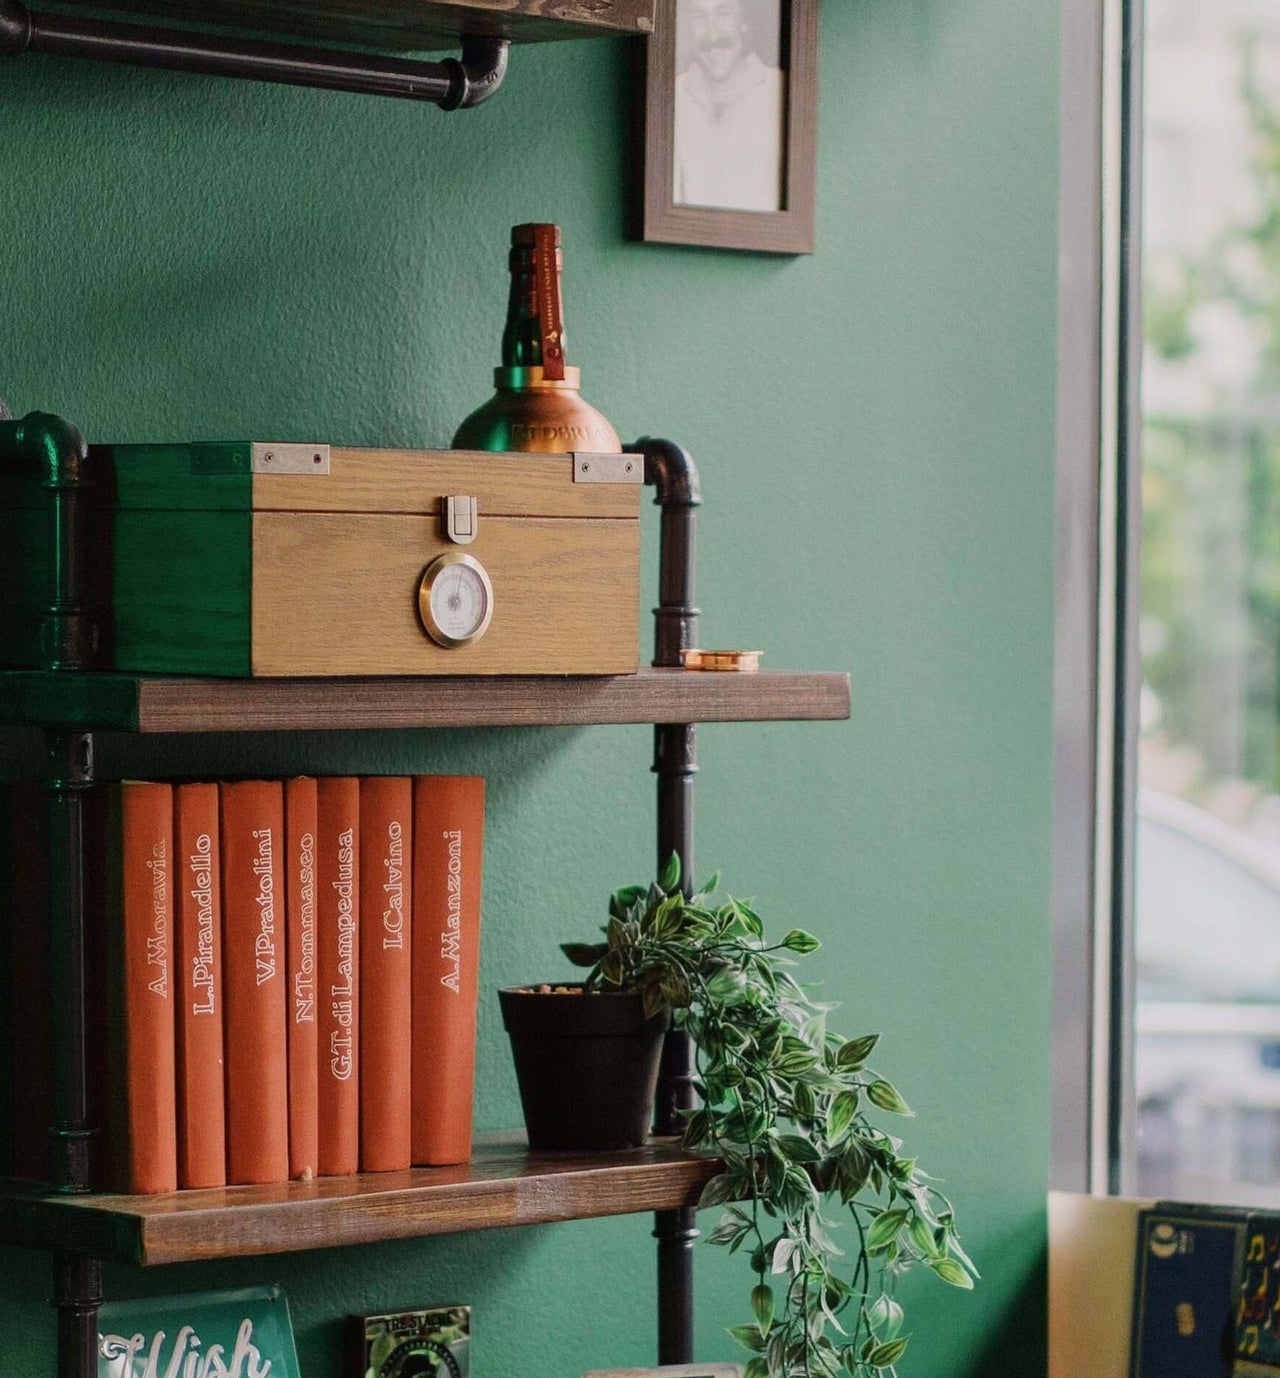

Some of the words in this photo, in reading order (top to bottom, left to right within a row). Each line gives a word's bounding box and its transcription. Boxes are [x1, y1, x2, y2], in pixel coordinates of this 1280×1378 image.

[147, 838, 168, 999] A.Moravia
[192, 833, 216, 1015] L.Pirandello
[253, 827, 276, 986] V.Pratolini
[296, 832, 315, 1023] N.Tommaseo
[383, 821, 404, 950] I.Calvino
[441, 830, 462, 993] A.Manzoni
